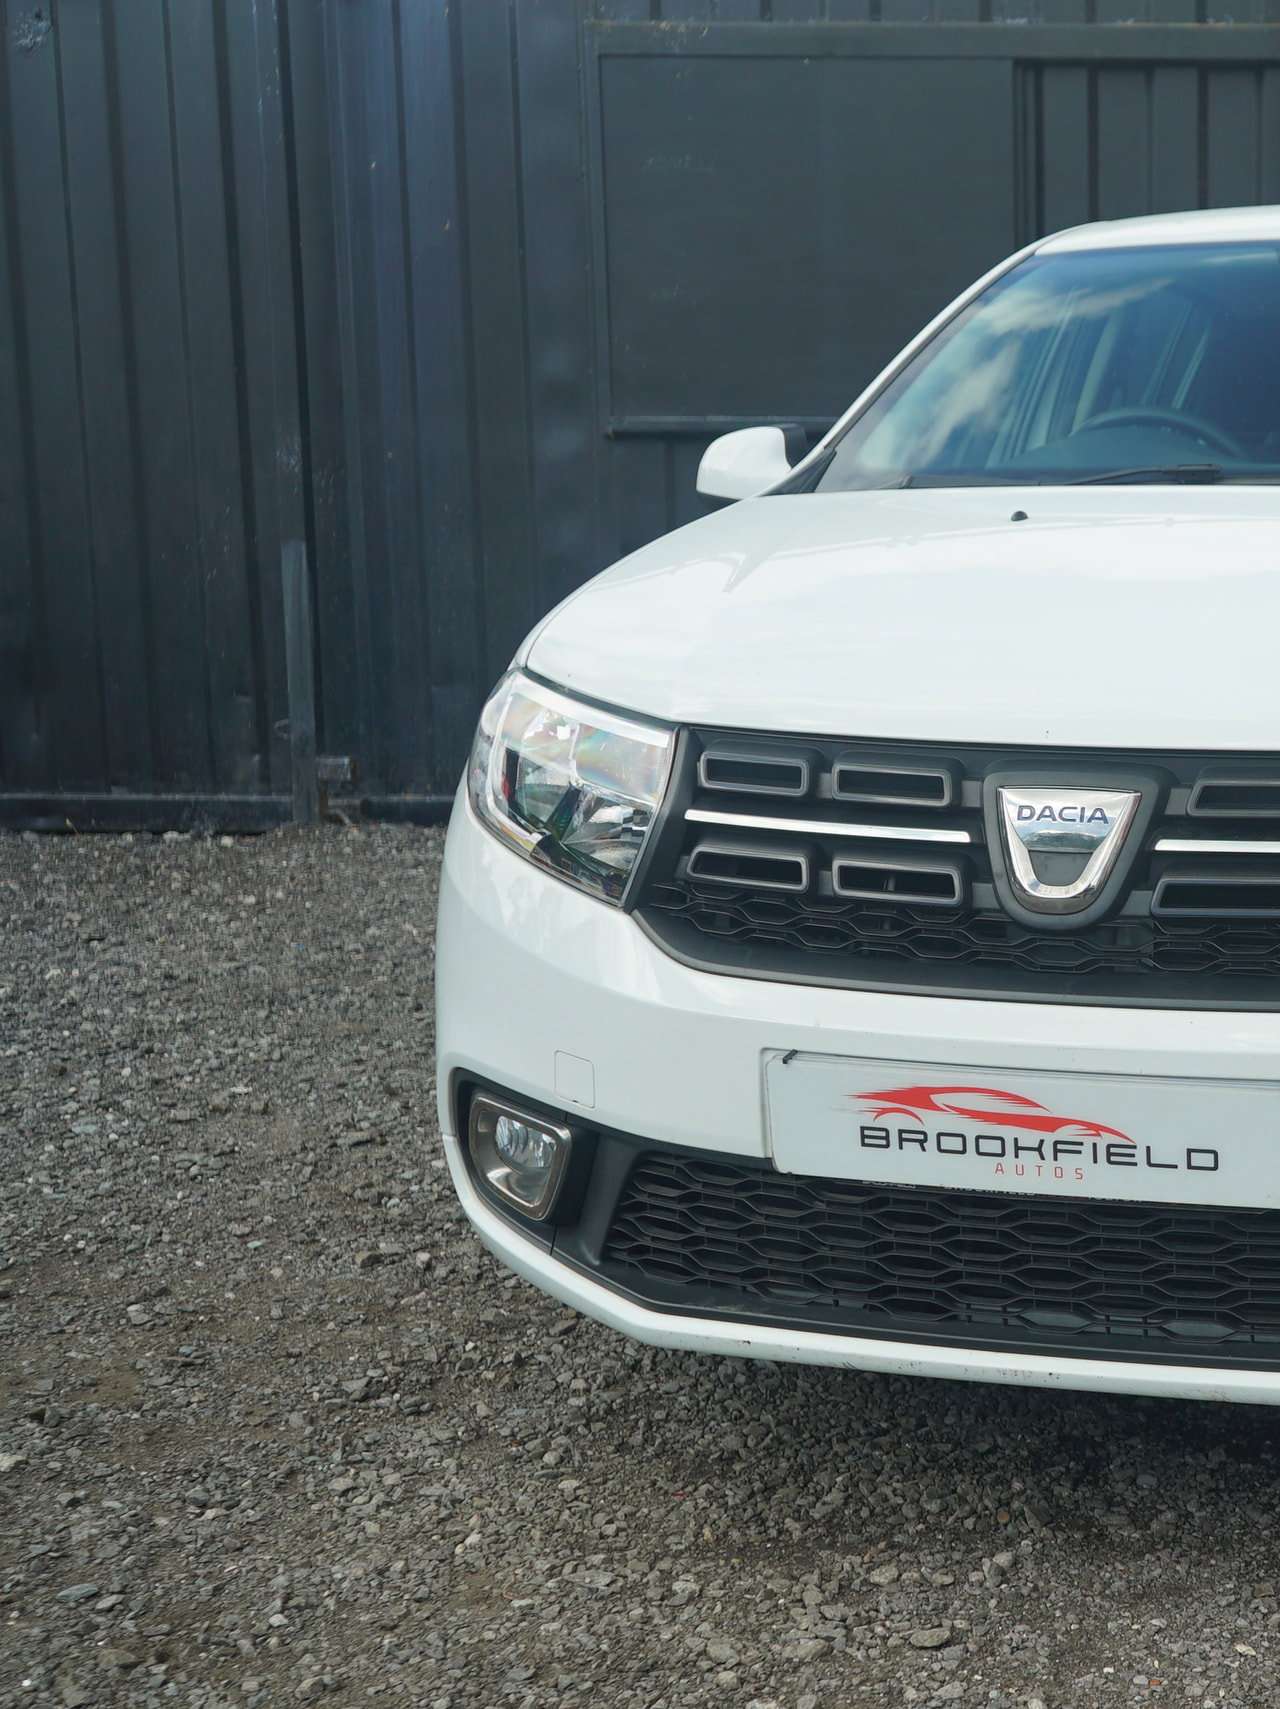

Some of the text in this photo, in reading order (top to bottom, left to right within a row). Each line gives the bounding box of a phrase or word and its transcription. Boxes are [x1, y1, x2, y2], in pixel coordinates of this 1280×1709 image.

[1016, 804, 1109, 825] DACIA
[859, 1125, 1220, 1172] BROOKFIELD
[994, 1161, 1084, 1181] AUTOS
